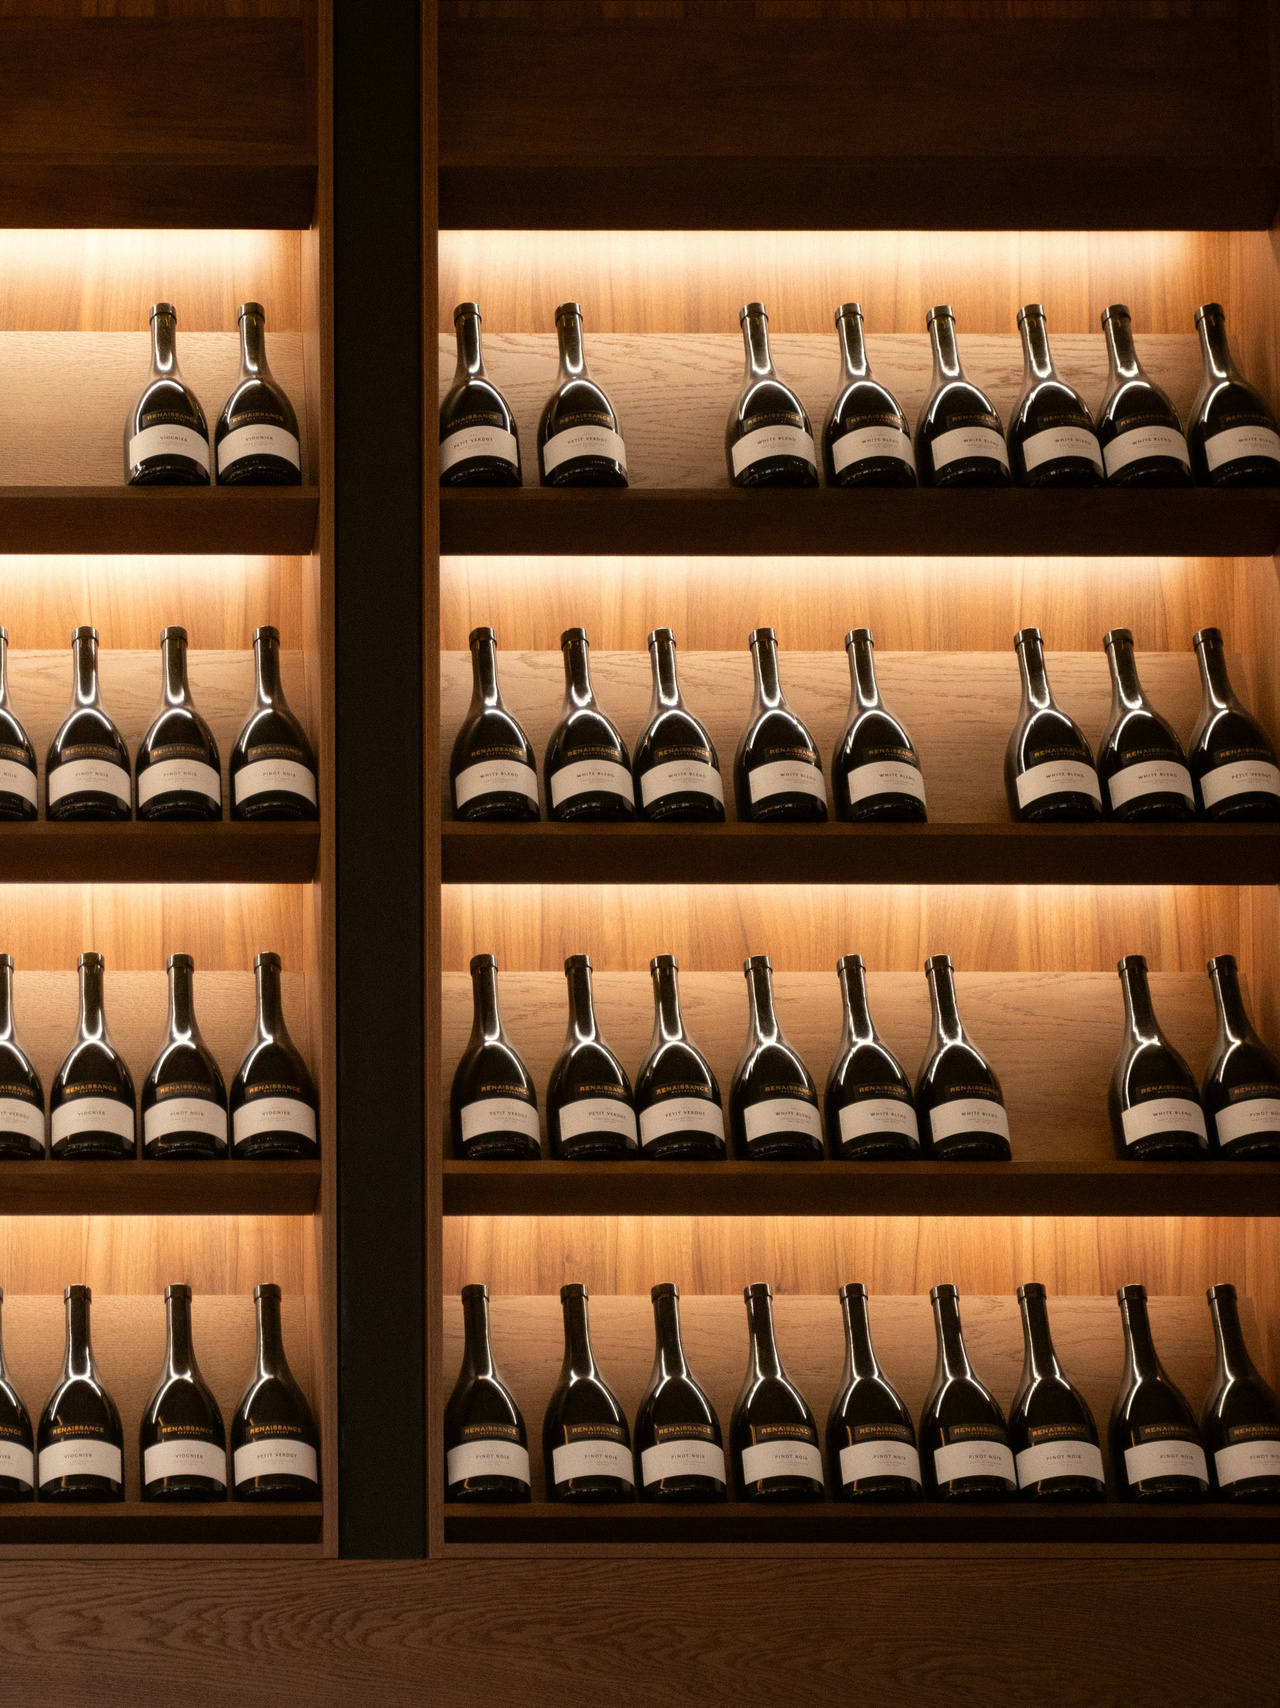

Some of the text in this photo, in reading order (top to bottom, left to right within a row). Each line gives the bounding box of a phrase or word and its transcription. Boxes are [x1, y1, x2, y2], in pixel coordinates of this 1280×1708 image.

[66, 1084, 117, 1094] RENAISSANCE
[160, 1084, 211, 1093] RENAISSANCE
[250, 1084, 300, 1093] RENAISSANCE
[656, 1084, 709, 1094] RENAISSANCE
[53, 1425, 105, 1434] RENAISSANCE
[250, 1425, 302, 1433] RENAISSANCE
[465, 1426, 517, 1435] RENAISSANCE
[659, 1426, 711, 1434] RENAISSANCE
